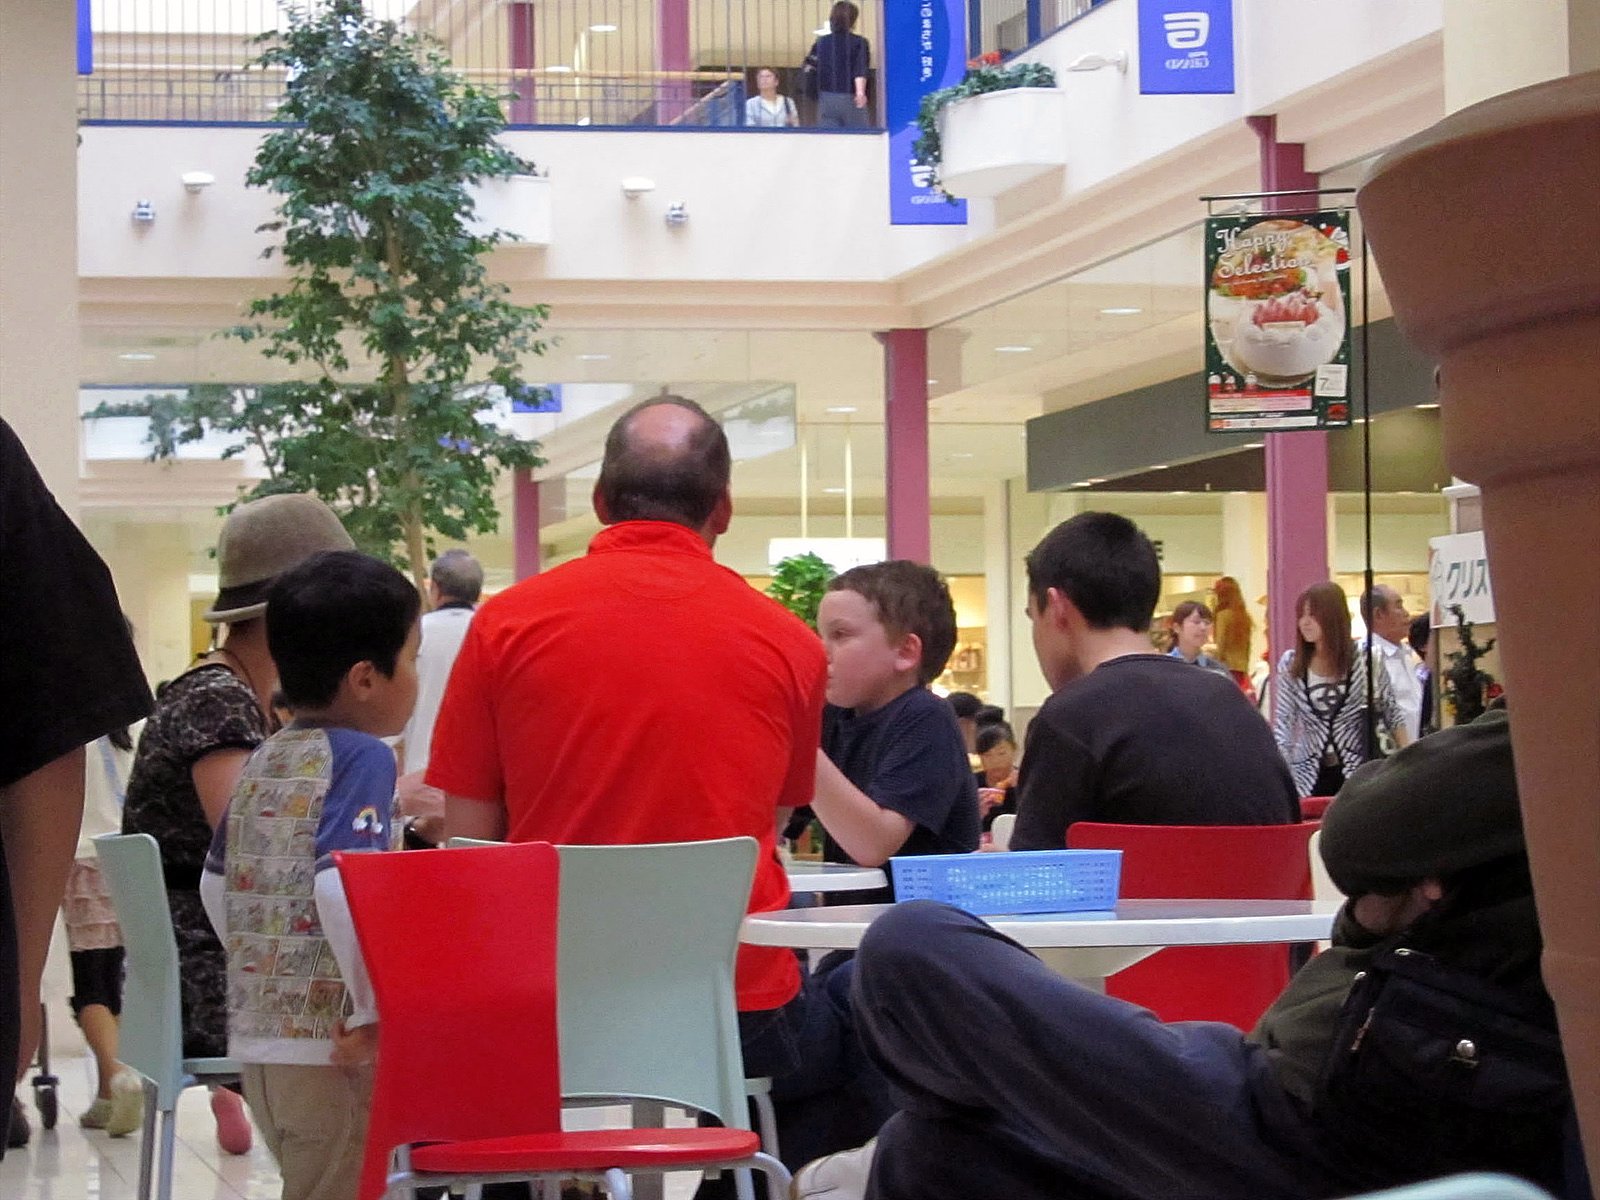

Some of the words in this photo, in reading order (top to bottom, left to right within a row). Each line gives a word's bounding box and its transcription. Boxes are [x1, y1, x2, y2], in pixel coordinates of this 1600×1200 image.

[1215, 227, 1289, 253] Happy
[1218, 253, 1313, 278] Selection
[1446, 559, 1488, 600] クリス
